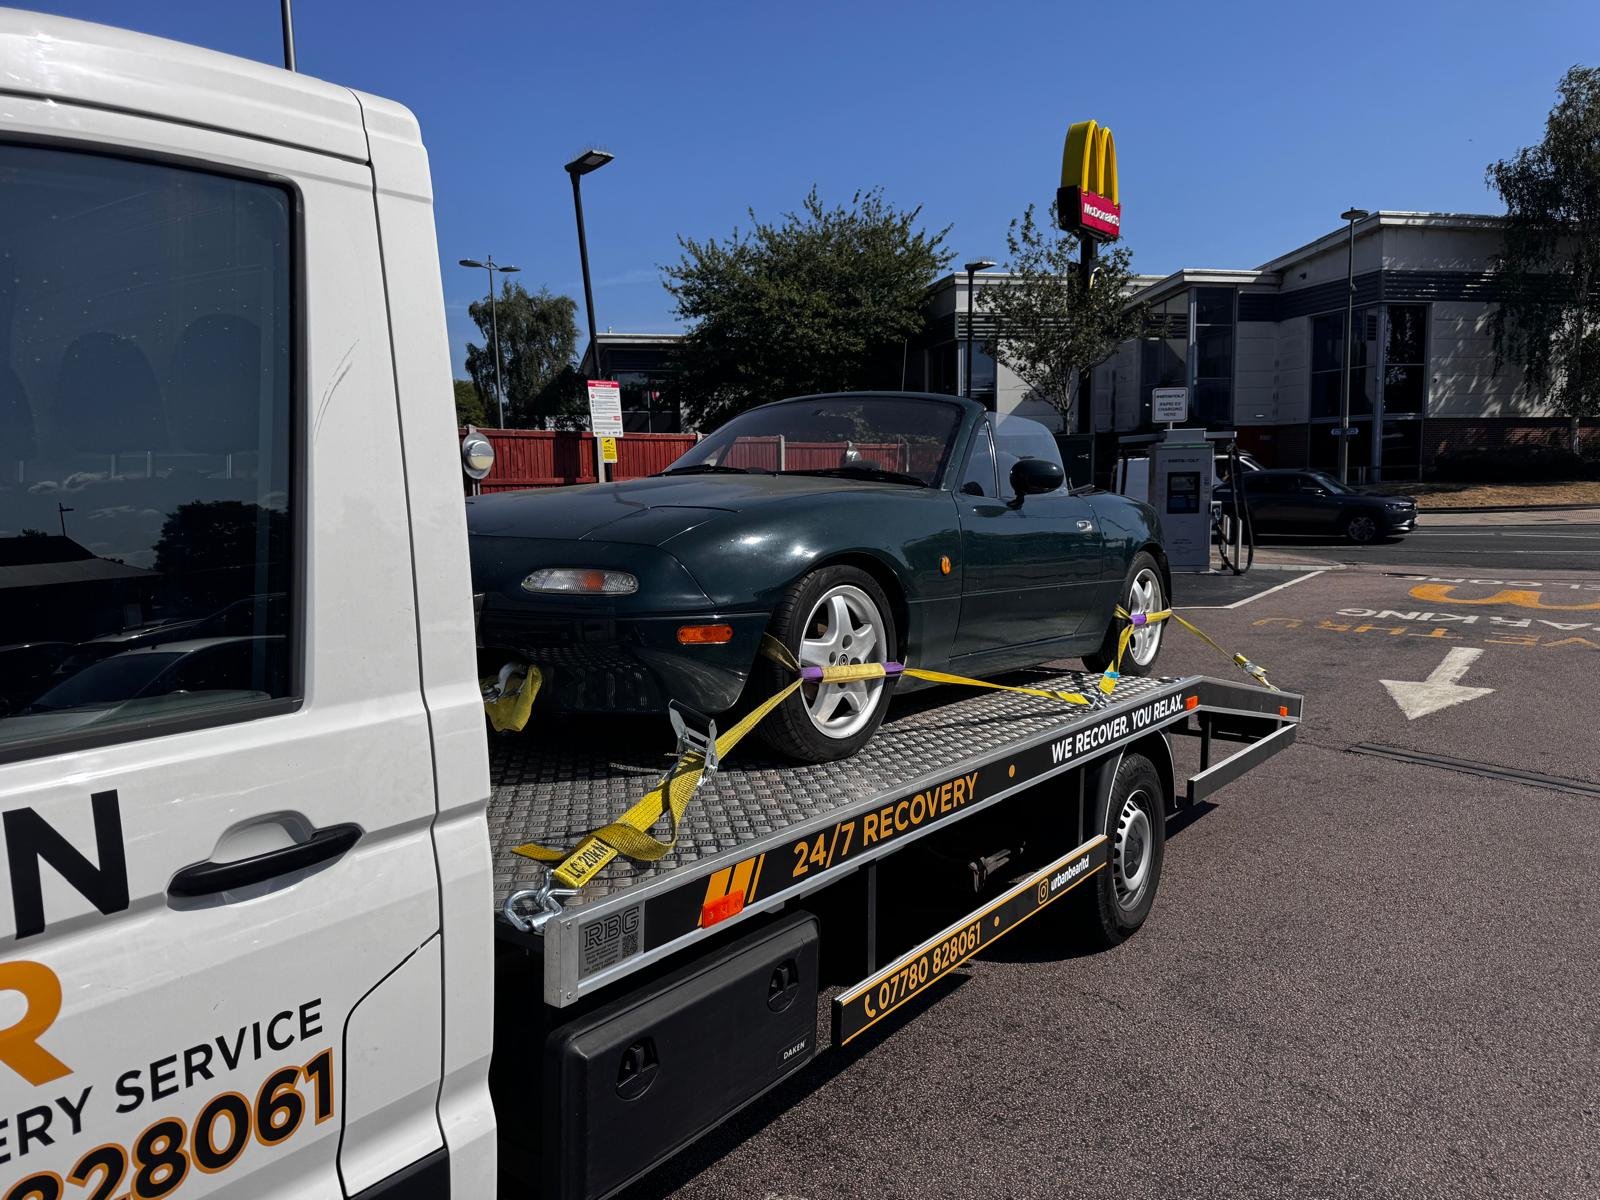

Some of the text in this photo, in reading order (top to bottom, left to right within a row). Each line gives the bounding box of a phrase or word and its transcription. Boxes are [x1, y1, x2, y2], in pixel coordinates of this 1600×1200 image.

[1052, 693, 1184, 764] WE RECOVER. YOU RELAX.
[792, 772, 979, 878] 24/7 RECOVERY
[564, 860, 586, 879] LC
[1050, 854, 1090, 892] urbanbearltd
[584, 905, 640, 952] RBG
[878, 921, 982, 1010] 07780 828061
[115, 997, 324, 1114] SERVICE
[783, 1041, 806, 1060] DAKEN
